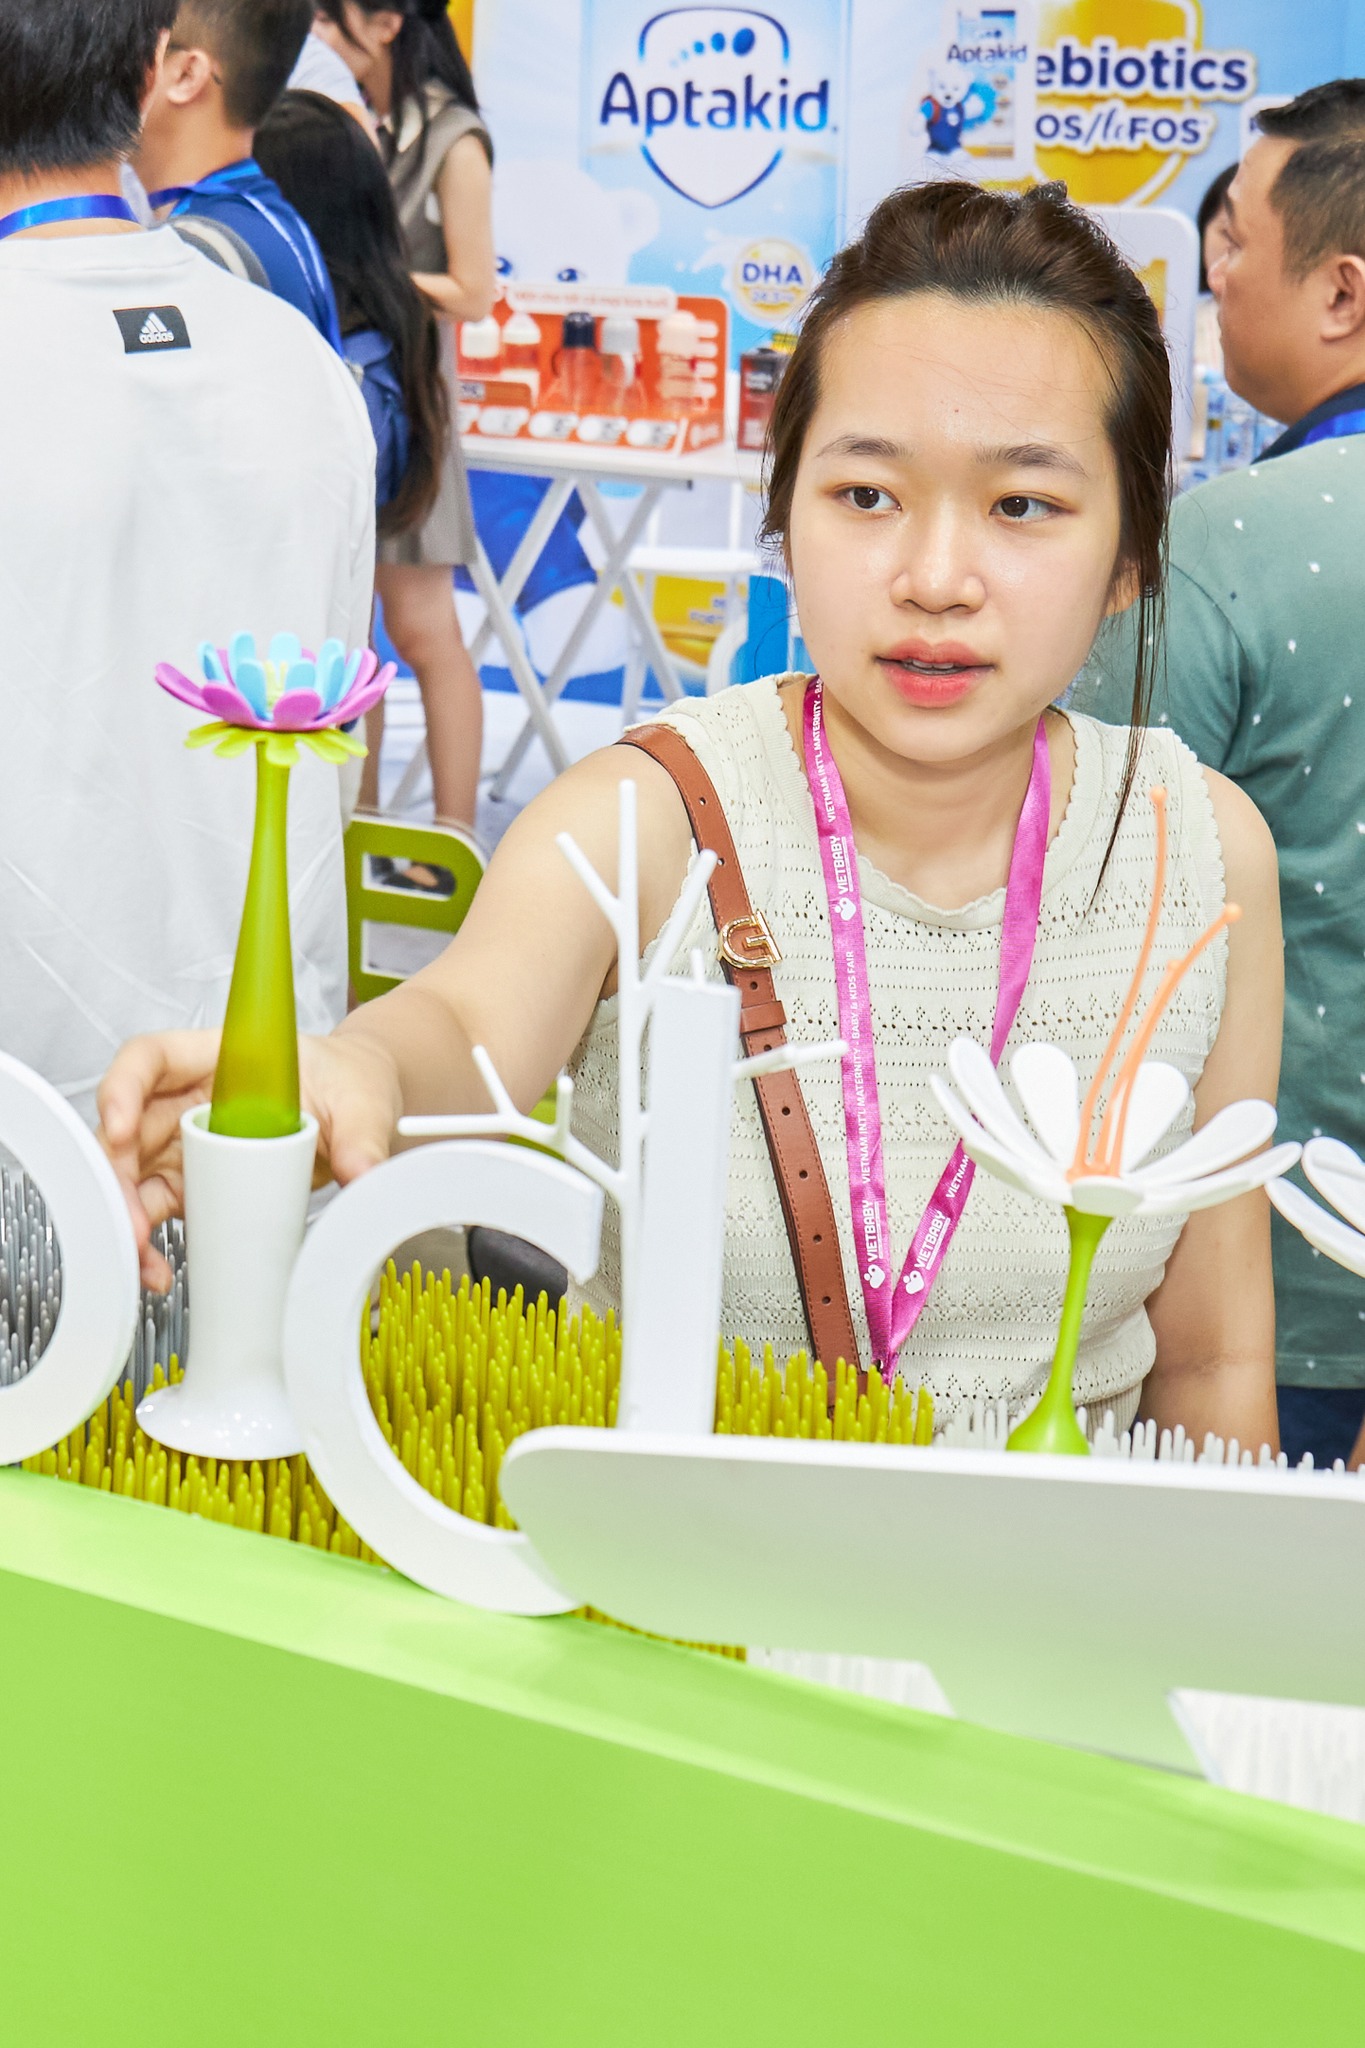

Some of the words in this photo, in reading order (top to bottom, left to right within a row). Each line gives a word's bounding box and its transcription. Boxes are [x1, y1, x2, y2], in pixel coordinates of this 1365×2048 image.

[947, 44, 1028, 65] Aptakid
[600, 71, 830, 138] Aptakid
[743, 262, 803, 285] DHA
[139, 329, 175, 344] adidas
[812, 700, 821, 751] MATERNITY
[820, 778, 836, 823] VIETNAM
[829, 835, 849, 895] VIETBABY
[845, 951, 856, 973] FAIR
[847, 975, 858, 1000] KIDS
[852, 1012, 861, 1039] BABY
[853, 1048, 866, 1106] MATERNITY
[859, 1137, 871, 1184] VIETNAM
[945, 1154, 970, 1199] VIETNAM
[862, 1200, 878, 1262] VIETBABY
[914, 1209, 946, 1269] VIETBABY
